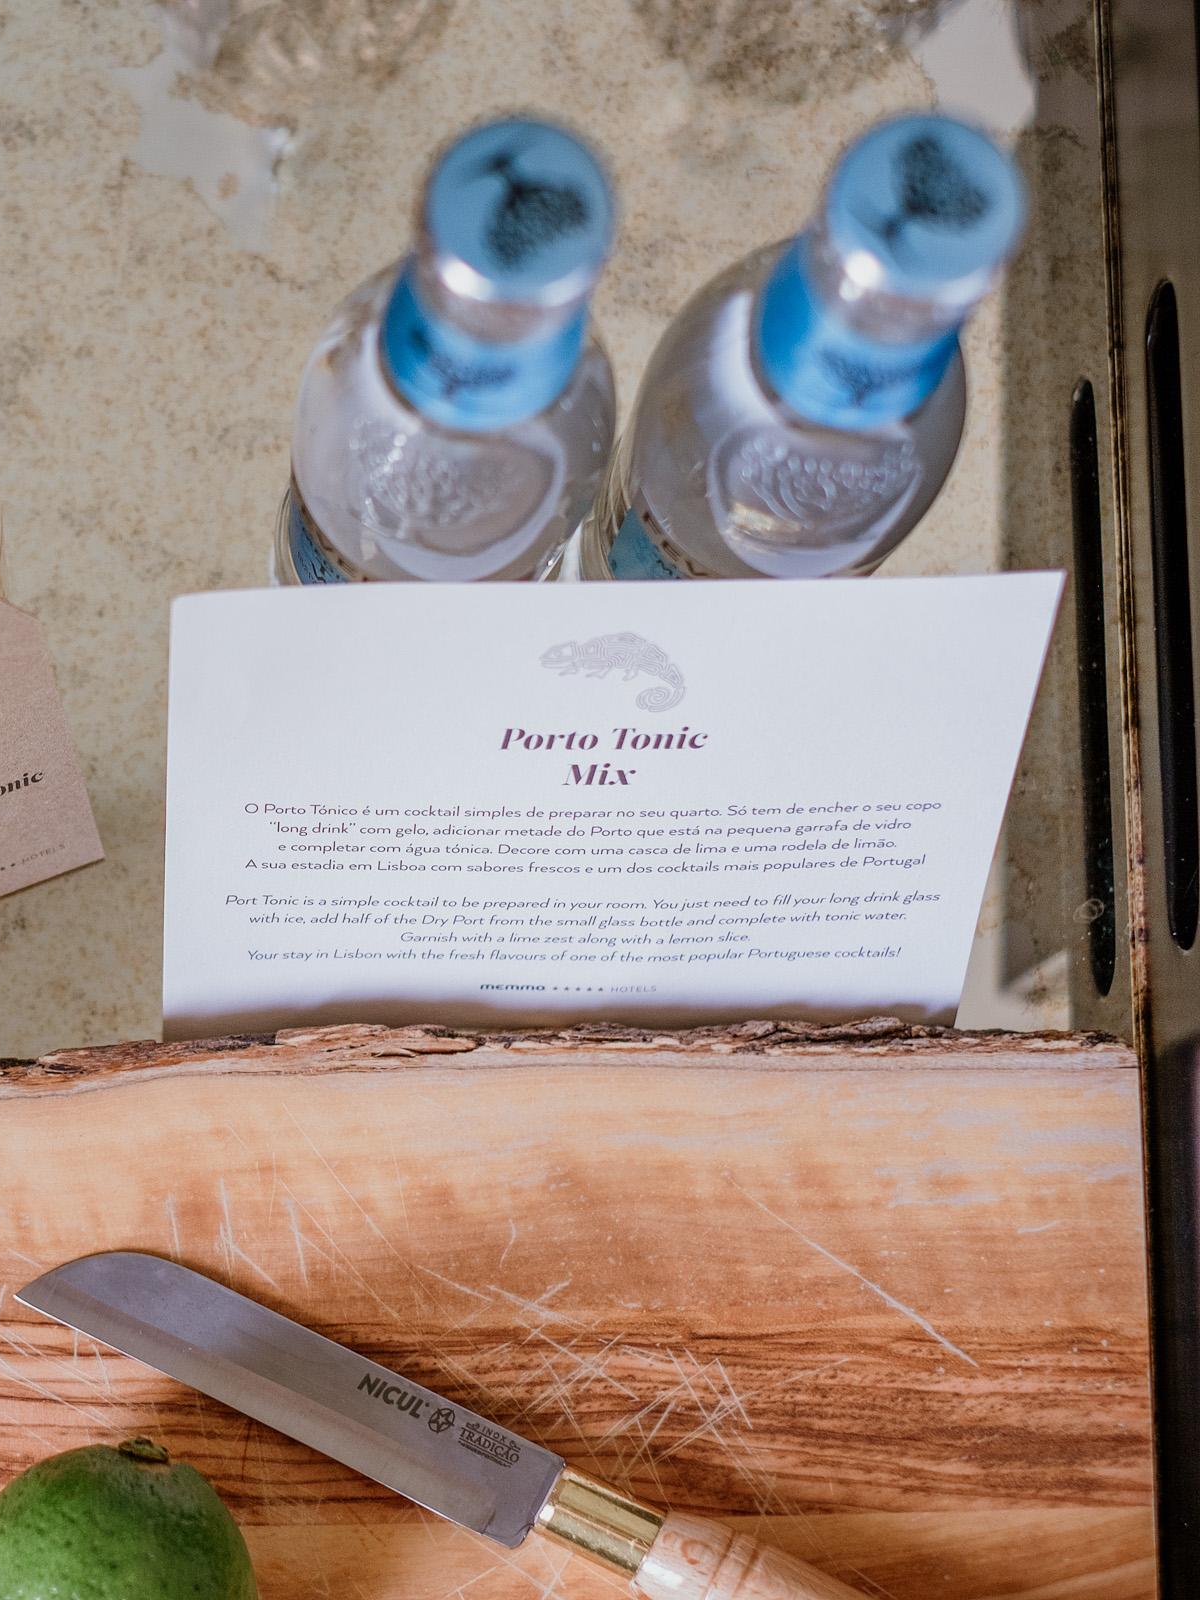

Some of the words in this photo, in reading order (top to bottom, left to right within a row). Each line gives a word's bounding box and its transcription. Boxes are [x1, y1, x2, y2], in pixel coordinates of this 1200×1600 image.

[500, 728, 599, 751] Porto
[611, 726, 709, 750] Tonic
[562, 763, 637, 787] Mix
[244, 803, 259, 814] O
[264, 803, 306, 815] Porto
[310, 804, 358, 816] Tónico
[362, 805, 371, 816] é
[404, 805, 460, 817] cocktail
[464, 806, 521, 820] simples
[526, 806, 545, 818] de
[548, 811, 613, 821] preparar
[616, 810, 635, 818] no
[639, 810, 665, 818] seu
[669, 808, 722, 820] quarto.
[727, 805, 747, 816] Só
[751, 807, 781, 816] tem
[786, 802, 805, 815] de
[808, 801, 859, 814] encher
[876, 804, 902, 812] seu
[905, 802, 942, 812] copo
[269, 821, 308, 837] “long
[312, 822, 356, 834] drink”
[395, 823, 429, 838] gelo,
[433, 824, 501, 836] adicionar
[504, 825, 562, 837] metade
[566, 825, 586, 837] do
[590, 826, 633, 837] Porto
[636, 829, 665, 839] que
[668, 825, 700, 836] está
[726, 826, 791, 837] pequena
[795, 819, 848, 836] garrafa
[852, 819, 871, 831] de
[875, 818, 912, 830] vidro
[21, 842, 66, 865] HOTELS
[290, 840, 366, 854] completar
[405, 843, 440, 857] água
[445, 843, 493, 854] tónica.
[498, 844, 550, 855] Decore
[628, 847, 668, 855] casca
[673, 843, 691, 855] de
[695, 842, 727, 854] lima
[744, 845, 777, 853] uma
[781, 839, 827, 851] rodela
[831, 838, 850, 850] de
[854, 837, 897, 849] limão.
[245, 859, 258, 869] A
[261, 862, 287, 870] sua
[291, 859, 344, 870] estadia
[348, 863, 372, 871] em
[377, 860, 426, 871] Lisboa
[466, 861, 524, 873] sabores
[528, 861, 580, 873] frescos
[598, 866, 622, 874] um
[626, 862, 653, 874] dos
[657, 860, 720, 873] cocktails
[724, 860, 759, 871] mais
[763, 857, 835, 873] populares
[839, 856, 858, 868] de
[862, 853, 926, 869] Portugal
[225, 895, 258, 906] Port
[262, 895, 299, 906] Tonic
[303, 895, 314, 906] is
[331, 895, 380, 909] simple
[383, 896, 440, 907] cocktail
[442, 899, 457, 907] to
[461, 896, 480, 908] be
[482, 897, 551, 911] prepared
[553, 899, 566, 908] in
[569, 902, 603, 911] your
[653, 899, 679, 910] You
[679, 899, 710, 912] just
[713, 895, 751, 907] need
[754, 898, 769, 906] to
[773, 894, 792, 905] fill
[793, 897, 827, 908] your
[829, 892, 860, 906] long
[863, 890, 900, 903] drink
[902, 890, 941, 905] glass
[249, 912, 280, 923] with
[284, 913, 306, 924] ice,
[310, 913, 339, 924] add
[342, 913, 372, 924] half
[374, 913, 391, 924] of
[394, 913, 417, 925] the
[422, 914, 449, 927] Dry
[452, 915, 485, 925] Port
[489, 914, 524, 926] from
[529, 915, 553, 926] the
[556, 915, 596, 927] small
[598, 916, 635, 930] glass
[639, 916, 683, 927] bottle
[686, 914, 716, 926] and
[718, 912, 786, 927] complete
[790, 910, 821, 922] with
[825, 911, 861, 921] tonic
[864, 912, 906, 920] water.
[400, 931, 457, 942] Garnish
[462, 932, 492, 943] with
[509, 932, 540, 943] lime
[577, 933, 617, 947] along
[621, 933, 652, 944] with
[668, 933, 714, 944] lemon
[717, 931, 750, 942] slice.
[248, 949, 279, 960] Your
[282, 951, 313, 962] stay
[316, 949, 329, 959] in
[333, 948, 382, 959] Lisbon
[386, 948, 417, 959] with
[421, 949, 445, 960] the
[449, 949, 485, 960] fresh
[490, 949, 546, 961] flavours
[550, 950, 568, 961] of
[600, 950, 618, 962] of
[620, 951, 643, 962] the
[647, 953, 685, 962] most
[687, 948, 744, 963] popular
[748, 948, 831, 961] Portuguese
[834, 946, 902, 958] cocktails!
[480, 983, 546, 992] memmo
[610, 985, 657, 993] HOTELS
[357, 1373, 422, 1419] NICUL
[481, 1426, 508, 1443] INOX
